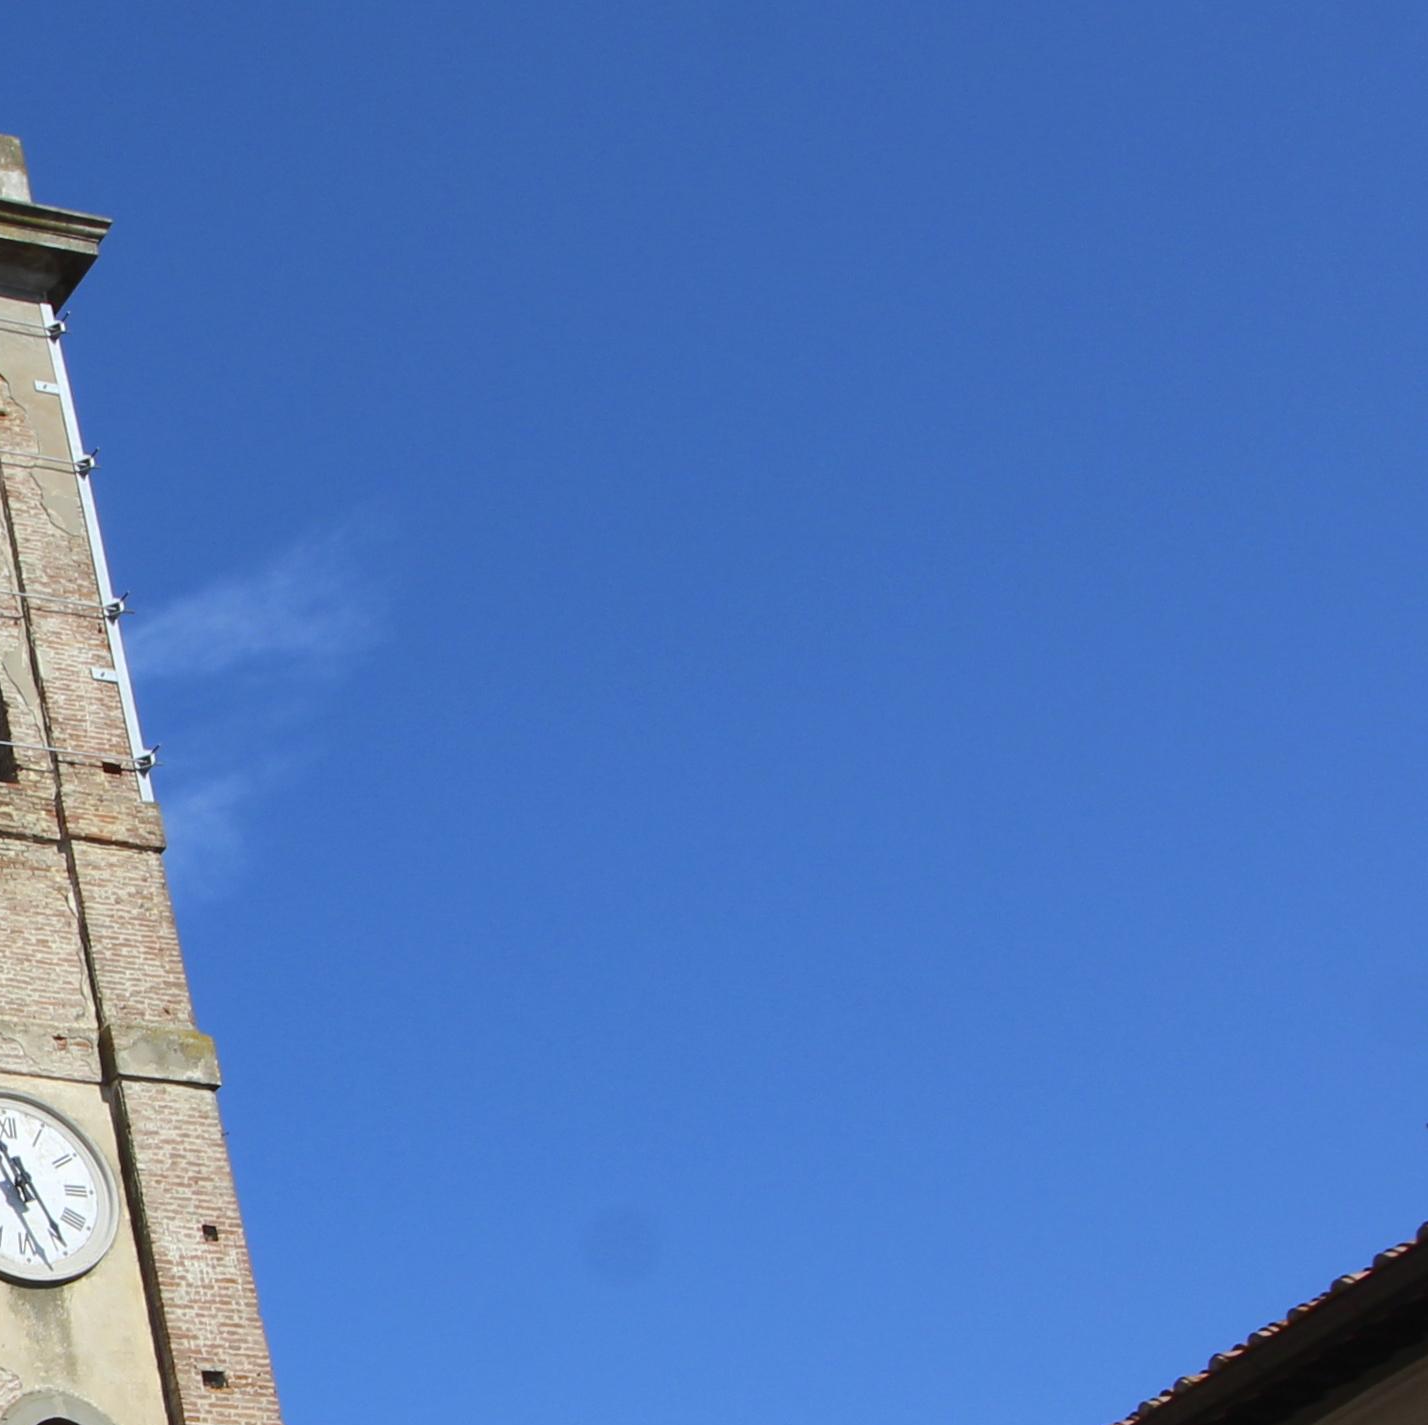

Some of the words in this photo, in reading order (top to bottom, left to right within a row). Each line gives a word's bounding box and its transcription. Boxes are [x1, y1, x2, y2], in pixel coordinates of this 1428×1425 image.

[52, 1153, 73, 1169] II
[64, 1184, 88, 1198] III
[60, 1207, 86, 1231] IIII
